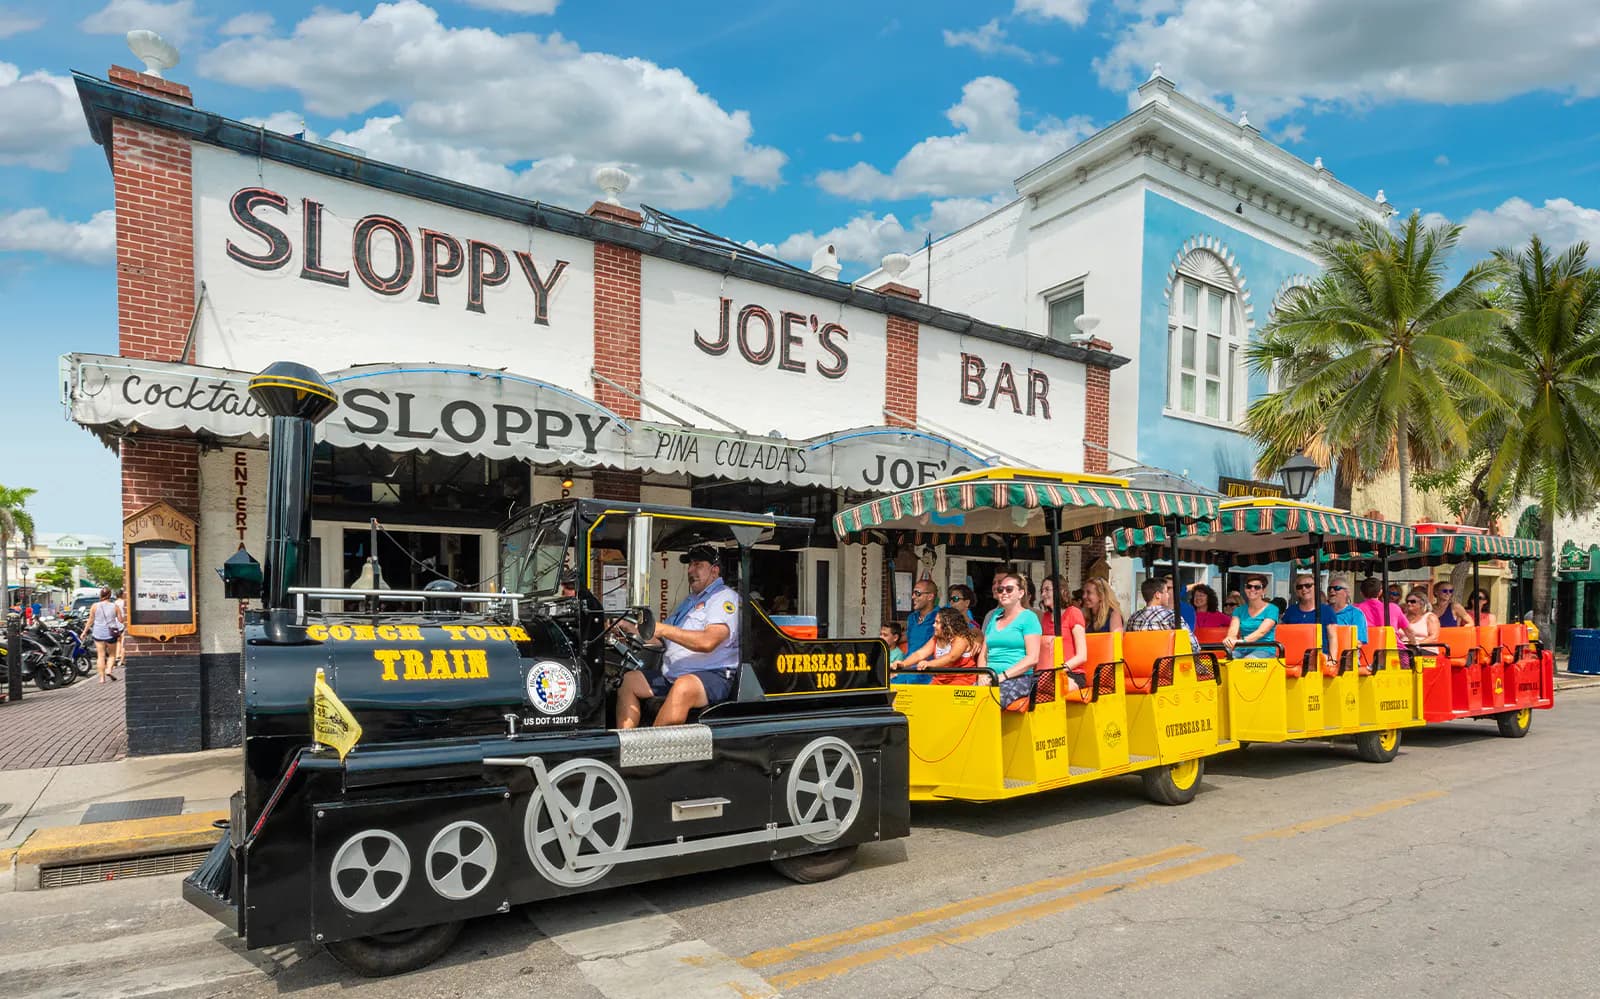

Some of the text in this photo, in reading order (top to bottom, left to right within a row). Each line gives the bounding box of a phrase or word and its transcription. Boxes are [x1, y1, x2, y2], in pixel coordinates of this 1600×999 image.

[226, 187, 1052, 420] SLOPPY JOE'S BAR
[122, 375, 267, 417] Cocktai
[343, 388, 610, 454] SLOPPY
[655, 432, 699, 463] PINA
[860, 547, 868, 635] COCKTAILS
[306, 624, 532, 642] CONCH TOUR
[374, 649, 489, 680] TRAIN
[776, 653, 843, 674] OVERSEAS
[816, 672, 837, 688] 108
[954, 690, 976, 698] CAUTION
[523, 718, 535, 726] US
[535, 717, 551, 725] DOT
[1165, 722, 1200, 738] OVERSEAS
[1045, 749, 1057, 761] KEY
